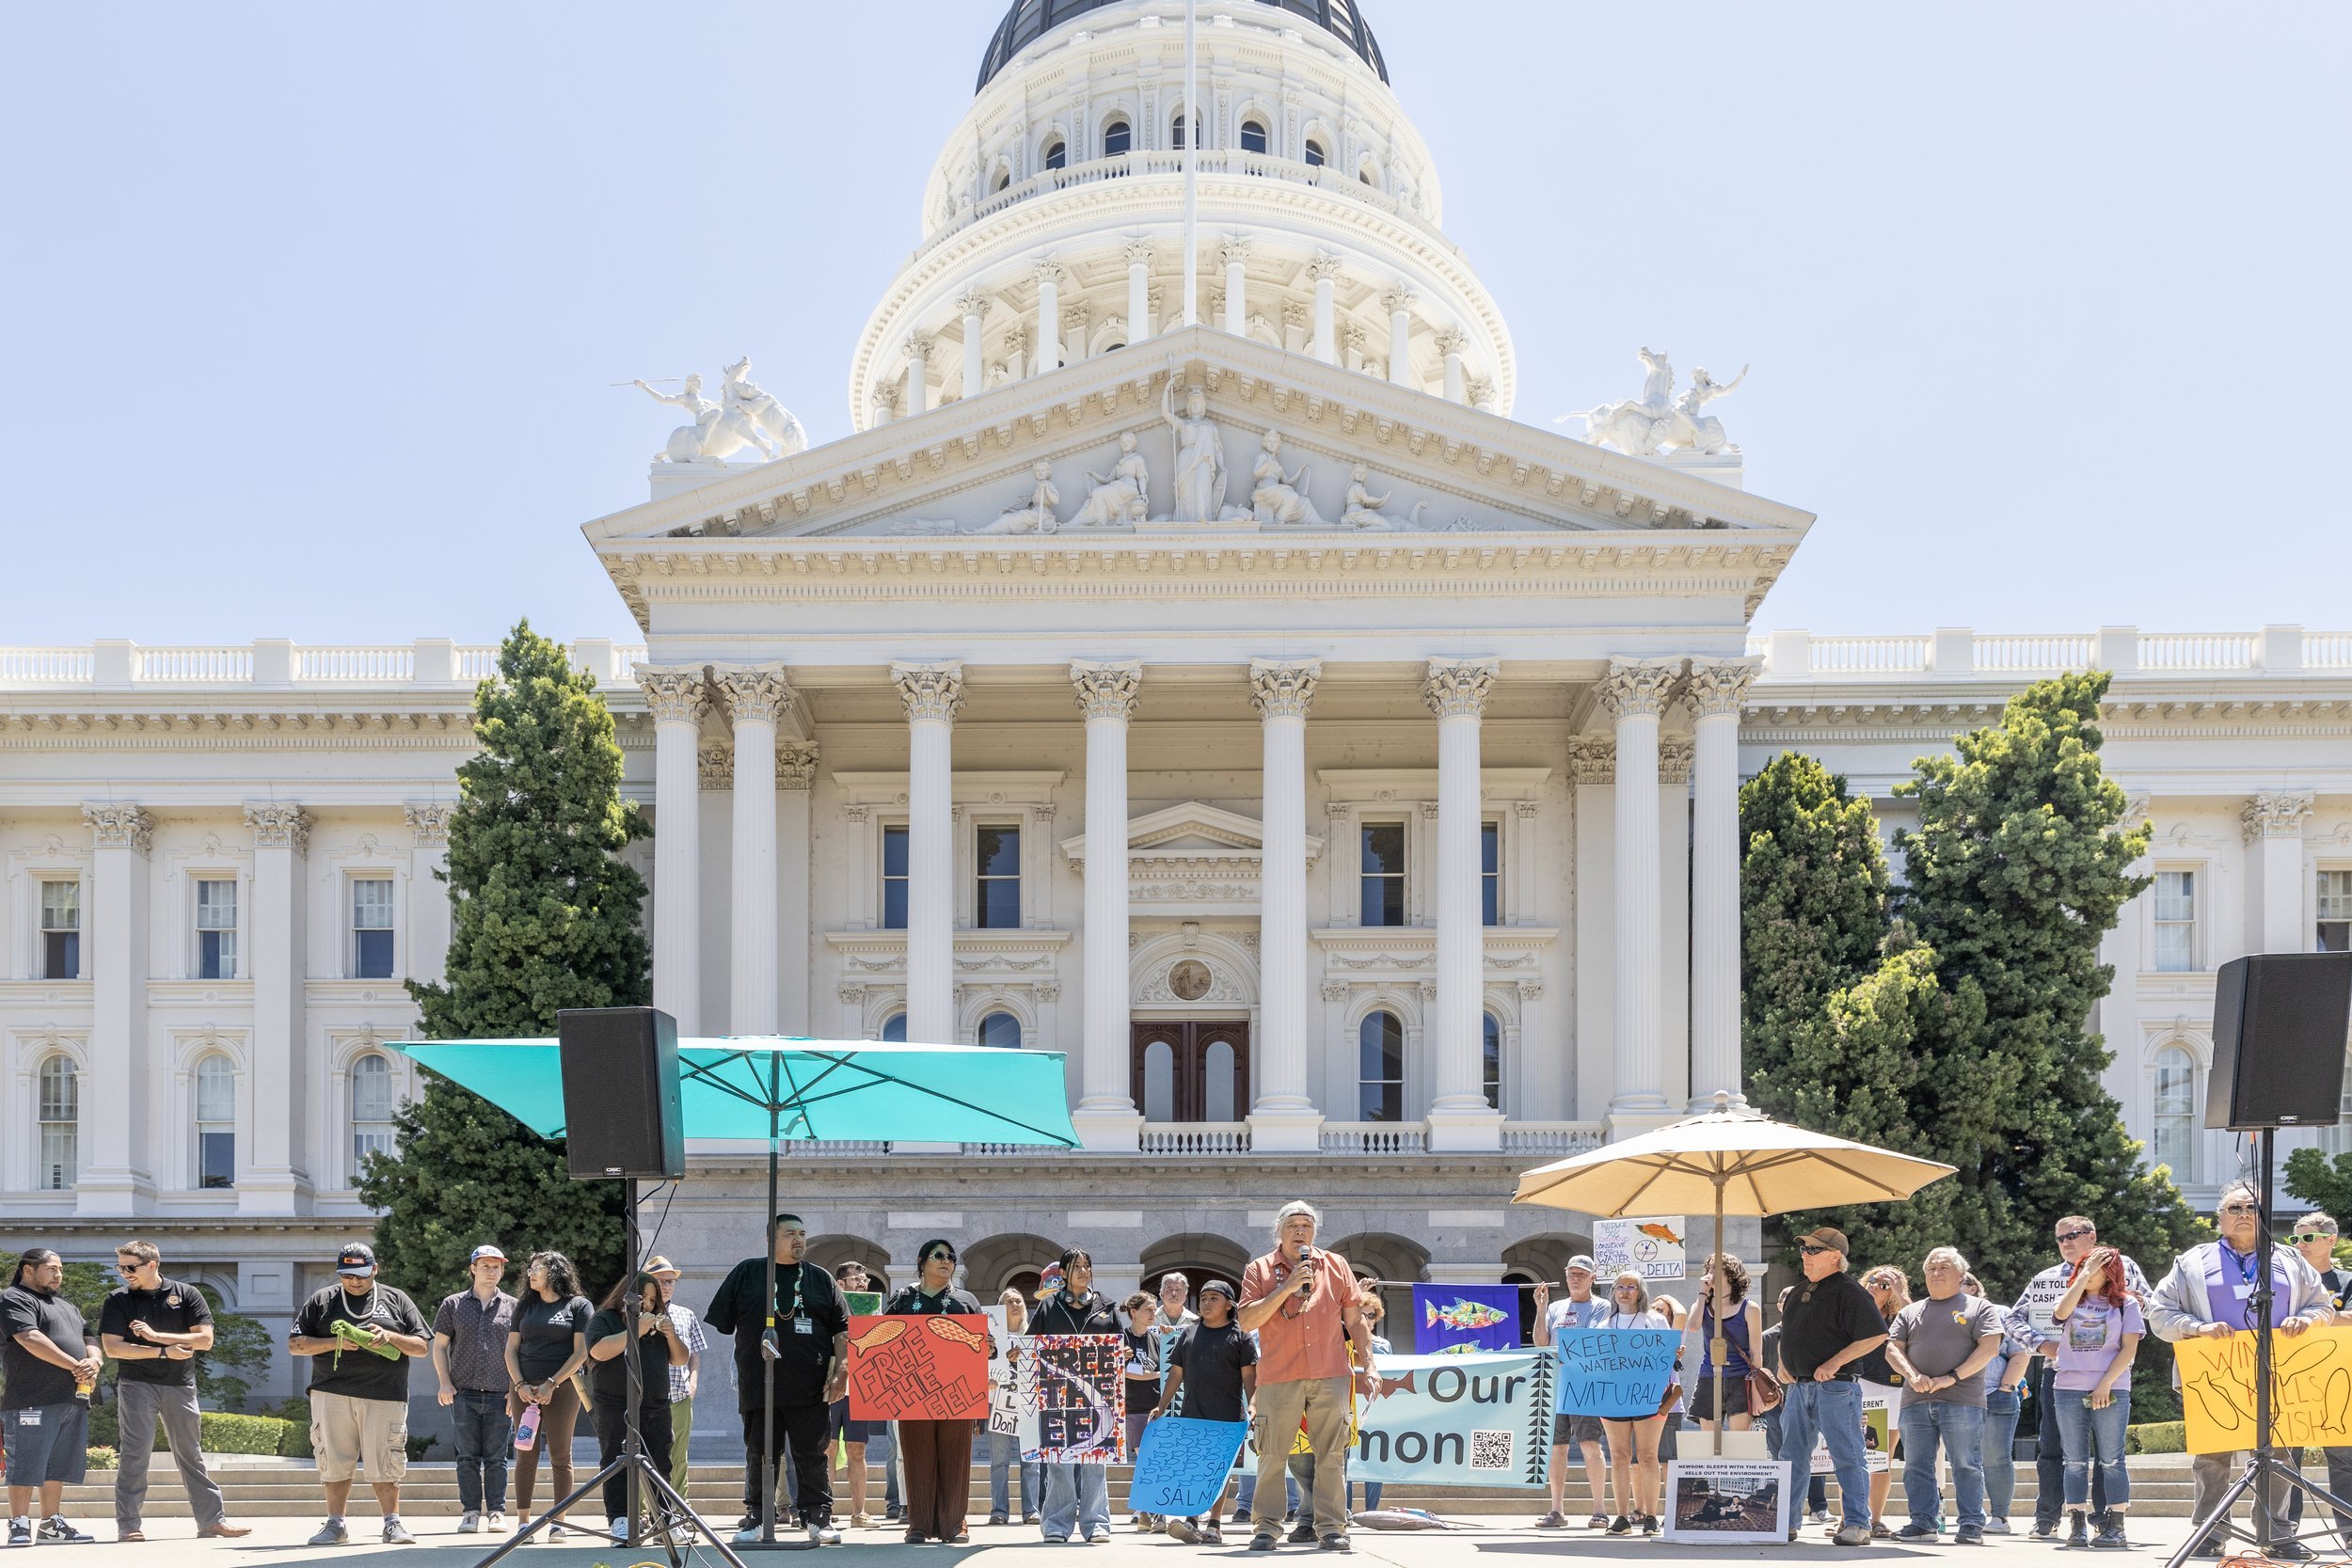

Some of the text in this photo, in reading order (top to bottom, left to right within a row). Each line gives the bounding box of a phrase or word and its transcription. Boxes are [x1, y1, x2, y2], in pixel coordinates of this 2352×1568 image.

[1597, 1255, 1630, 1264] WATER
[1647, 1262, 1682, 1276] DELTA
[2032, 1293, 2056, 1303] CASH
[2033, 1280, 2046, 1289] WE
[1562, 1333, 1666, 1360] KEEP OUR
[852, 1325, 935, 1403] FREE
[1039, 1345, 1115, 1379] FREE
[1580, 1350, 1670, 1373] WATERWAYS
[873, 1362, 943, 1418] THE
[923, 1374, 987, 1420] EEL
[1039, 1376, 1115, 1410] THE
[1428, 1366, 1527, 1404] Our
[1563, 1381, 1662, 1410] NATURAL
[2246, 1375, 2325, 1407] KLLS
[1863, 1400, 1884, 1408] ERENT
[992, 1412, 1019, 1434] Don't
[1358, 1429, 1465, 1465] mon
[1203, 1460, 1231, 1477] SA
[1155, 1487, 1221, 1506] SALMO
